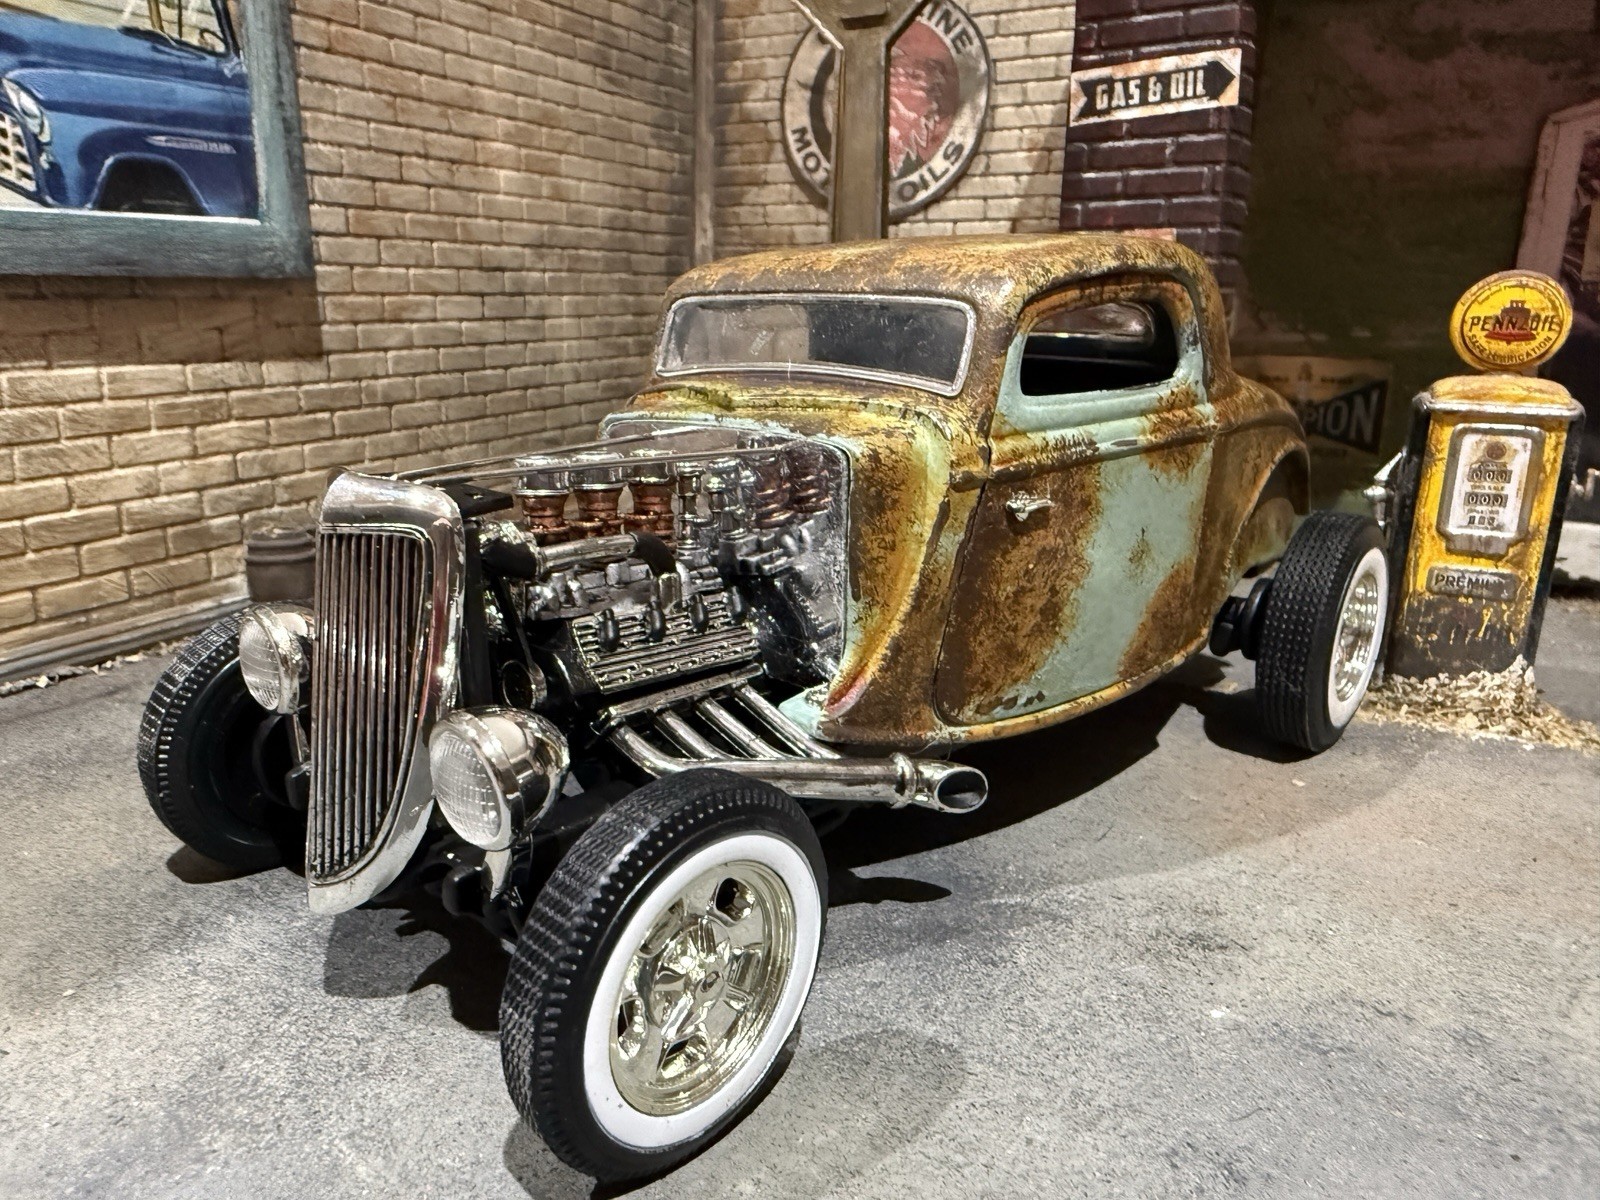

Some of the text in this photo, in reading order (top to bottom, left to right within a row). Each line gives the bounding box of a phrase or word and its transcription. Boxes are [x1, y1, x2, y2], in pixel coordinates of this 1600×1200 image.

[924, 0, 974, 55] INE
[1096, 69, 1206, 111] GAS & OIL
[791, 126, 964, 202] MOT OILS
[1303, 389, 1380, 444] PION
